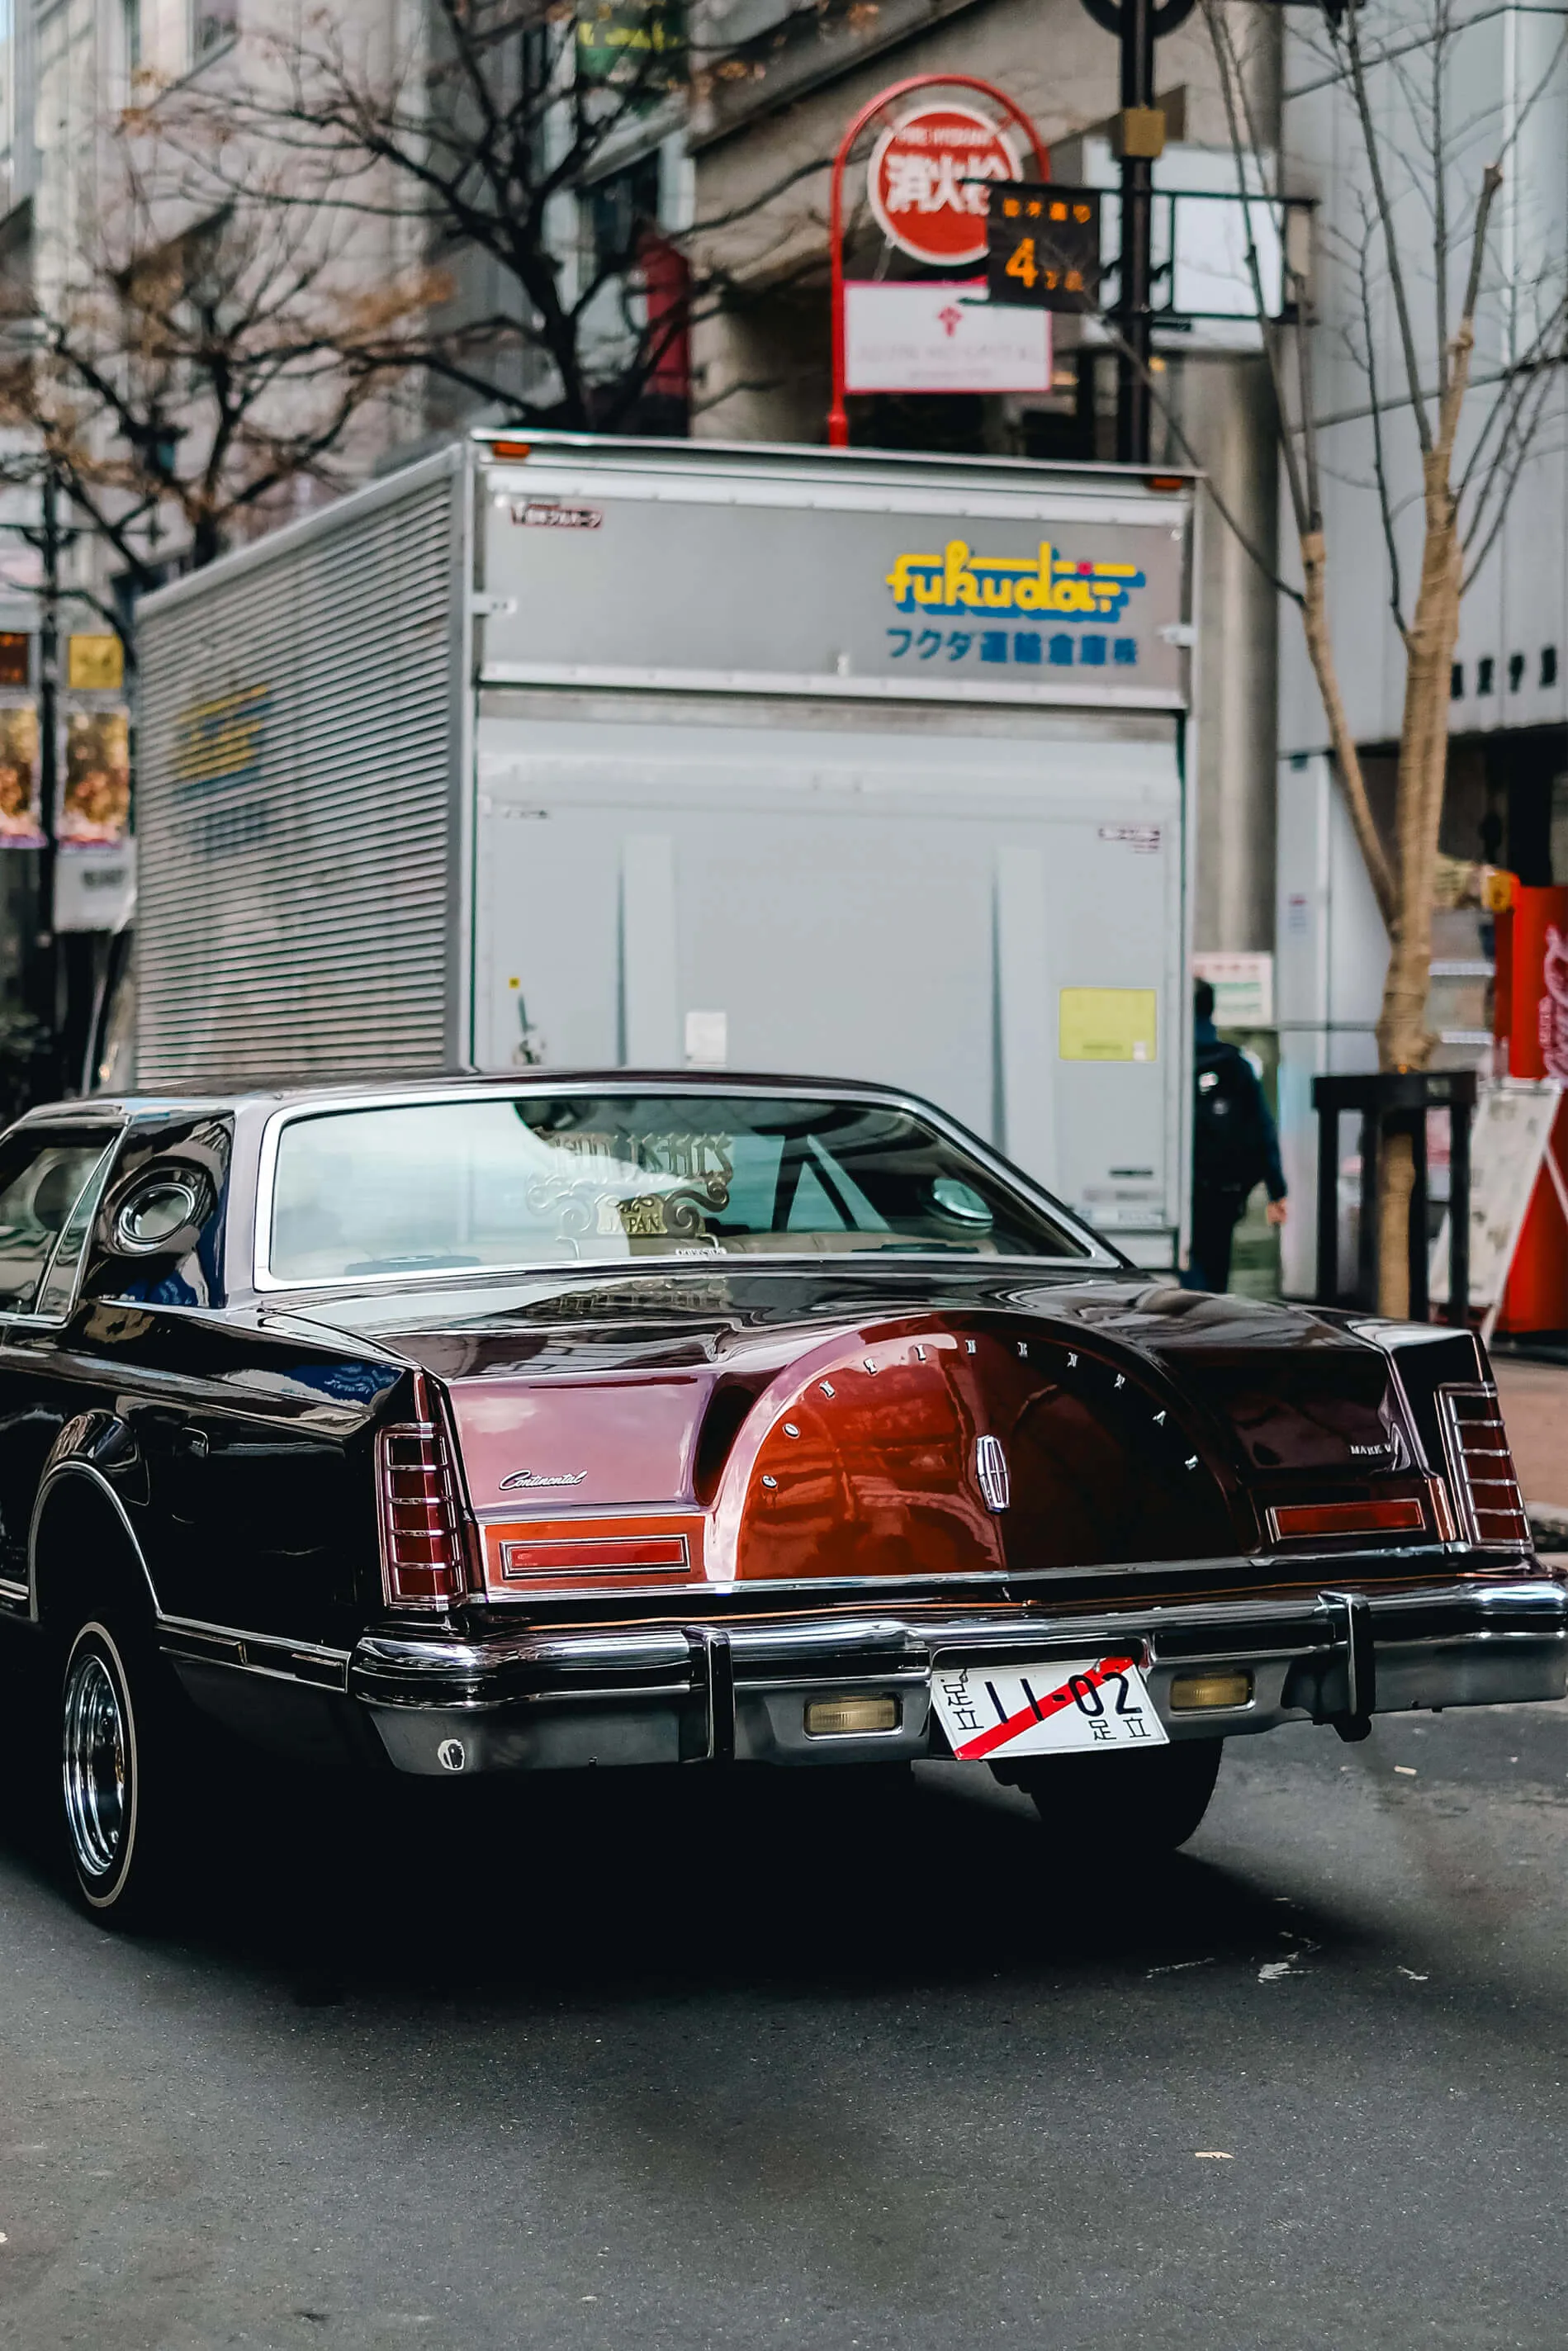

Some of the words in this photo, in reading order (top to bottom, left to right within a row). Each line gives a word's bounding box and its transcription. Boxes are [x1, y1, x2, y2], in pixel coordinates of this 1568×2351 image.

[1349, 1444, 1383, 1455] MARK
[499, 1469, 588, 1490] Continental
[943, 1682, 985, 1731] 足立
